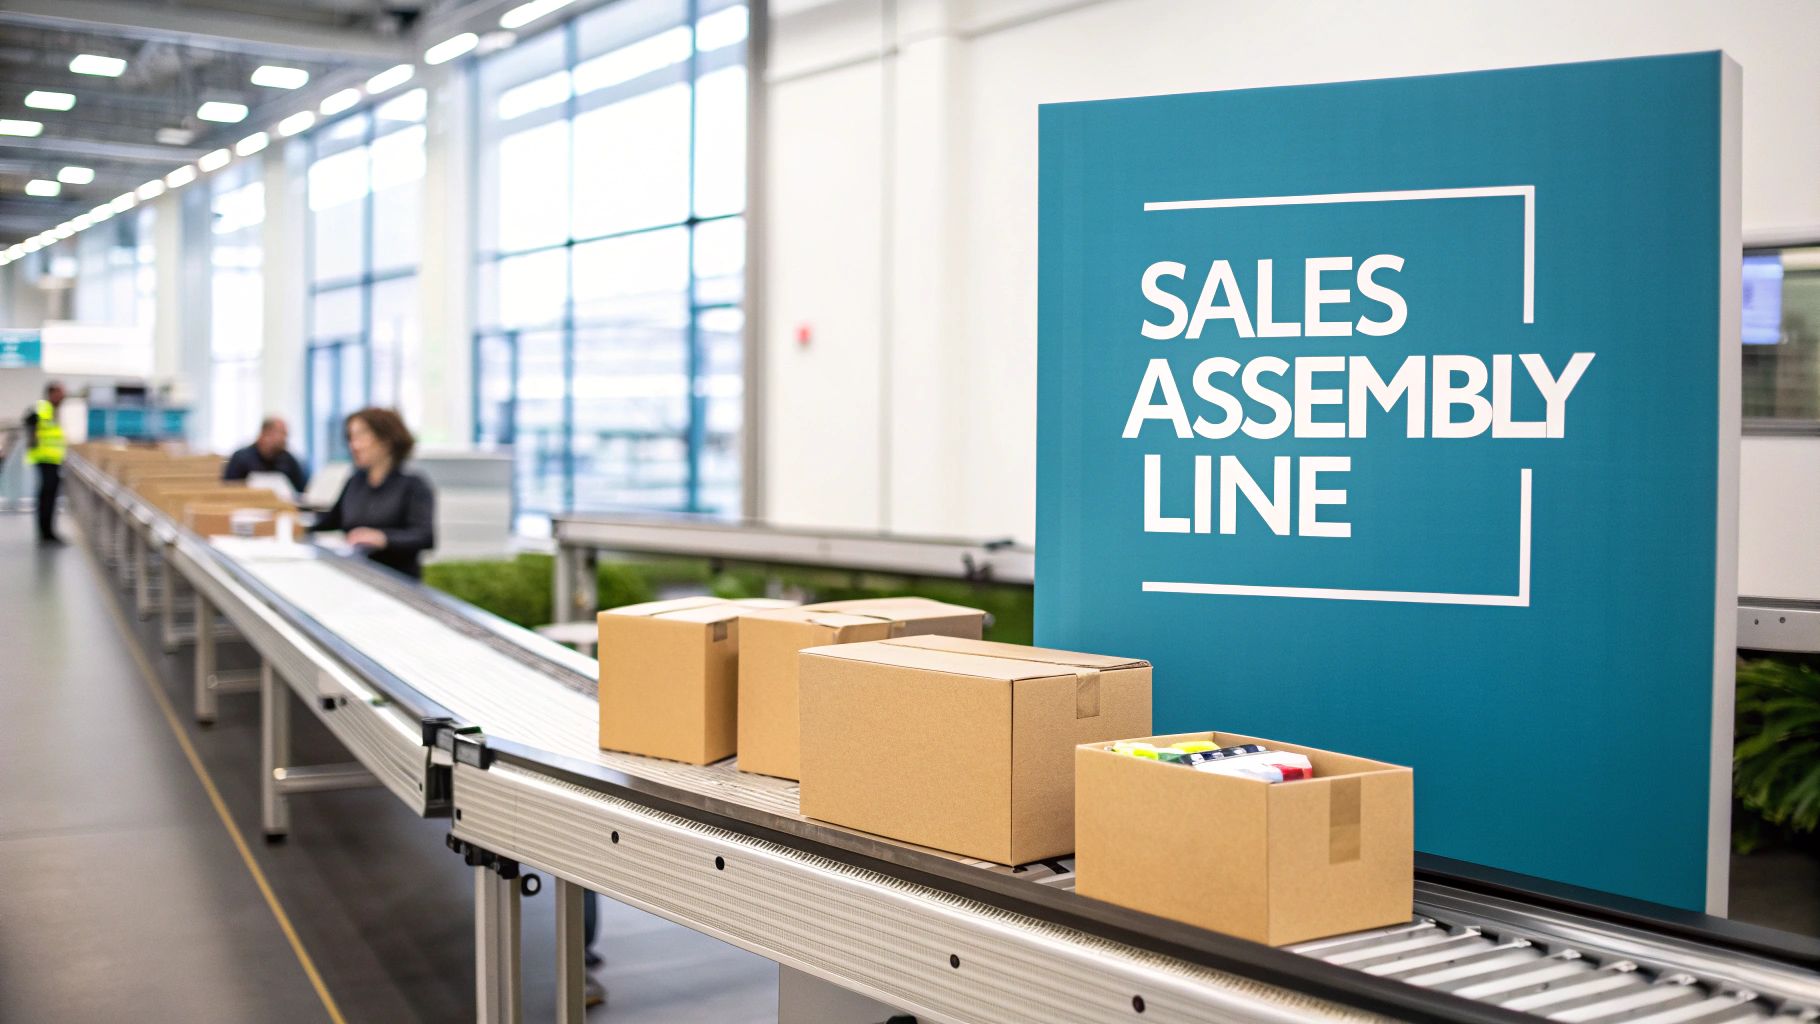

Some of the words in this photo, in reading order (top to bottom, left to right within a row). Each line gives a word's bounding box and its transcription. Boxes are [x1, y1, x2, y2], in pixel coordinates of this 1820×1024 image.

[1141, 254, 1408, 340] SALES
[1122, 352, 1596, 440] ASSEMBLY
[1143, 454, 1352, 538] LINE
